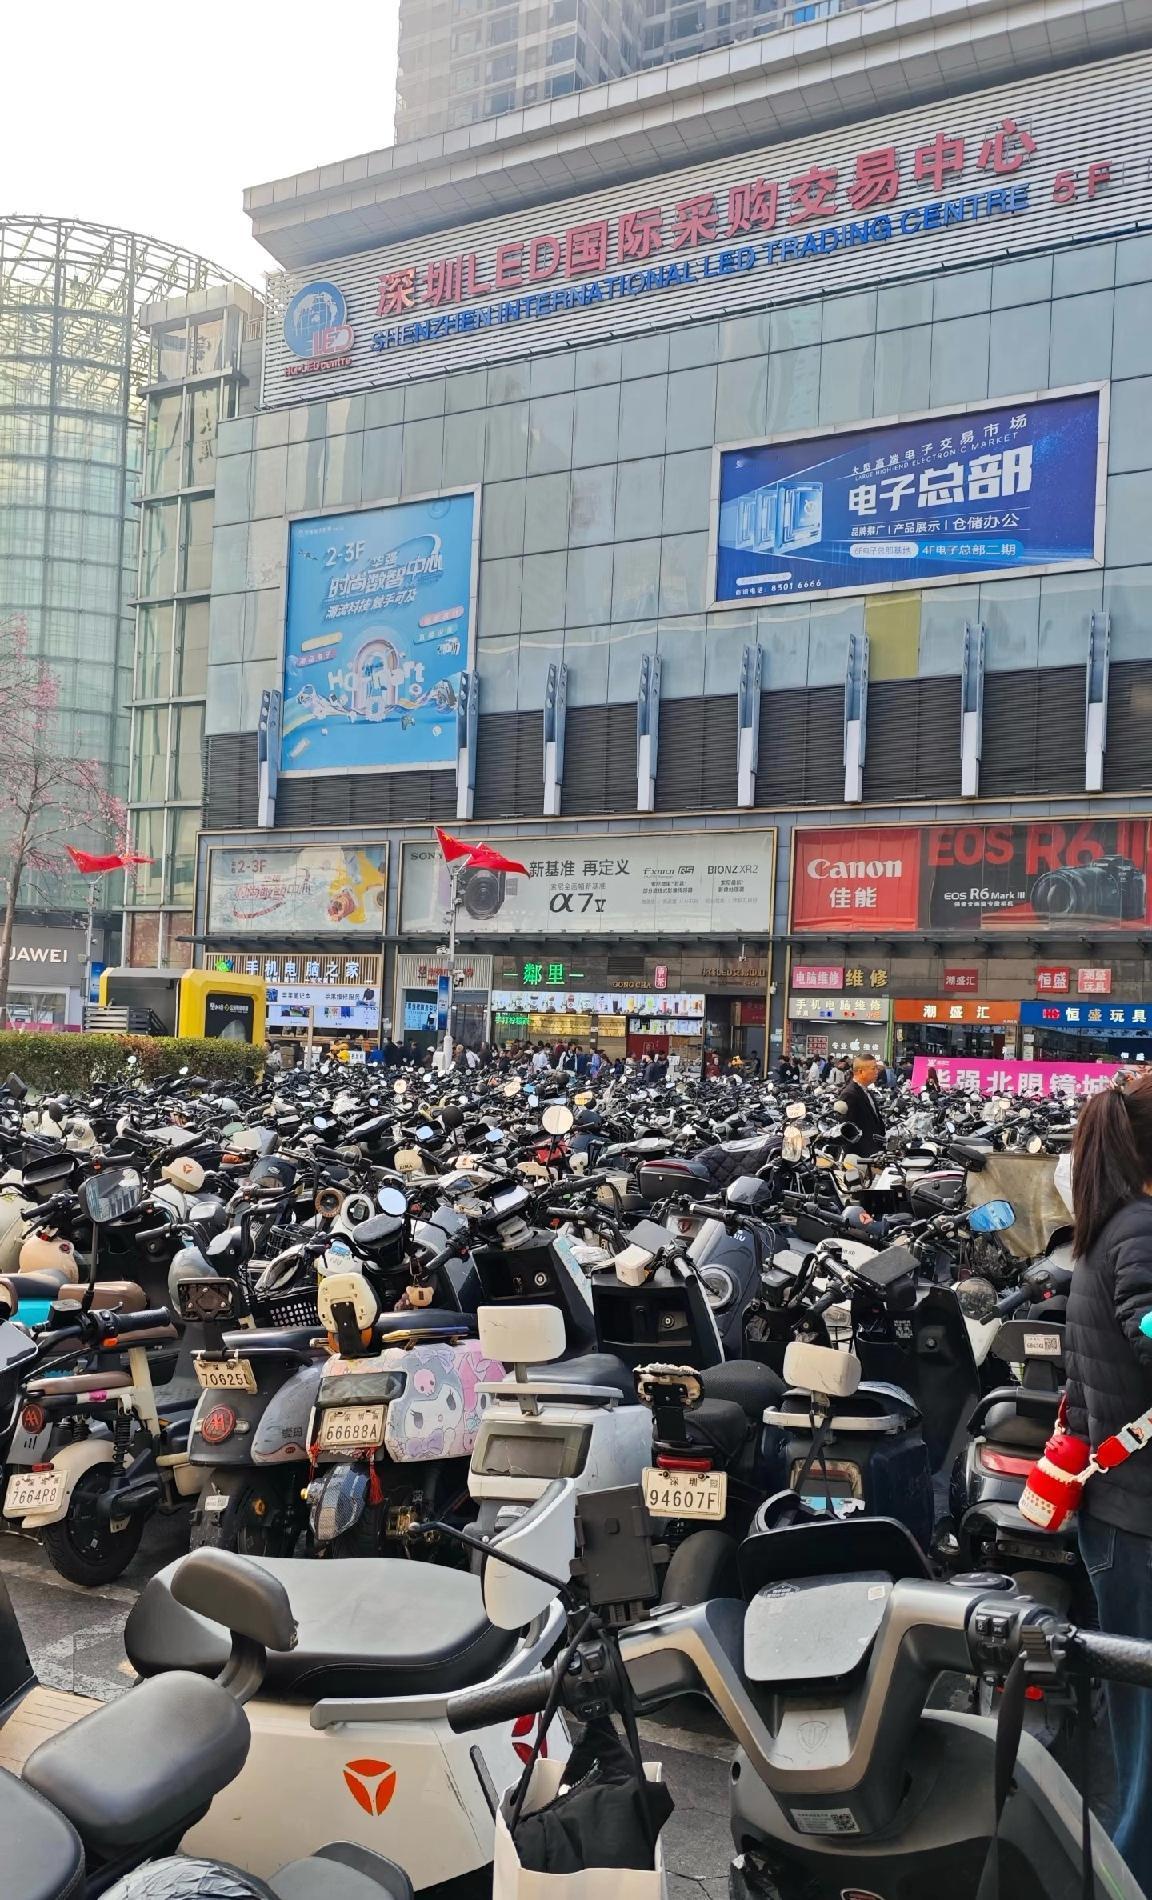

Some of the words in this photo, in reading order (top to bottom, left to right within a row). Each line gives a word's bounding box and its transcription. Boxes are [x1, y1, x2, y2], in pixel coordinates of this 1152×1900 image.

[376, 118, 1037, 317] 深圳LED国际采购交易中心
[372, 306, 501, 352] SHENZHEN
[501, 261, 698, 324] INTERNATIONAL
[703, 247, 756, 277] LED
[763, 214, 892, 266] TRADING
[900, 182, 1031, 235] CENTRE
[971, 432, 1019, 450] MARKET
[848, 444, 1033, 515] 电子总部
[893, 520, 940, 534] 产品展示
[952, 512, 1020, 531] 仓储办公
[326, 540, 366, 567] 2-3F
[922, 543, 1016, 556] 4F电子总部二期
[771, 582, 793, 592] 8501
[797, 579, 821, 589] 6666
[928, 824, 1015, 867] EOS
[529, 859, 575, 877] 新基准
[582, 858, 630, 877] 再定义
[807, 858, 902, 879] Canon
[829, 886, 877, 909] 佳能
[944, 892, 966, 900] EOS
[969, 888, 989, 900] R6
[991, 890, 1015, 900] Mark
[246, 960, 359, 979] 手机电脑之家
[796, 971, 839, 985] 电脑维修
[845, 968, 887, 988] 维修
[1038, 972, 1067, 989] 恒盛
[795, 999, 881, 1011] 手机电脑维修
[923, 1005, 990, 1019] 潮盛汇
[1066, 1007, 1147, 1023] 恒盛玩具
[669, 1476, 698, 1487] 深圳
[649, 1489, 717, 1509] 94607F
